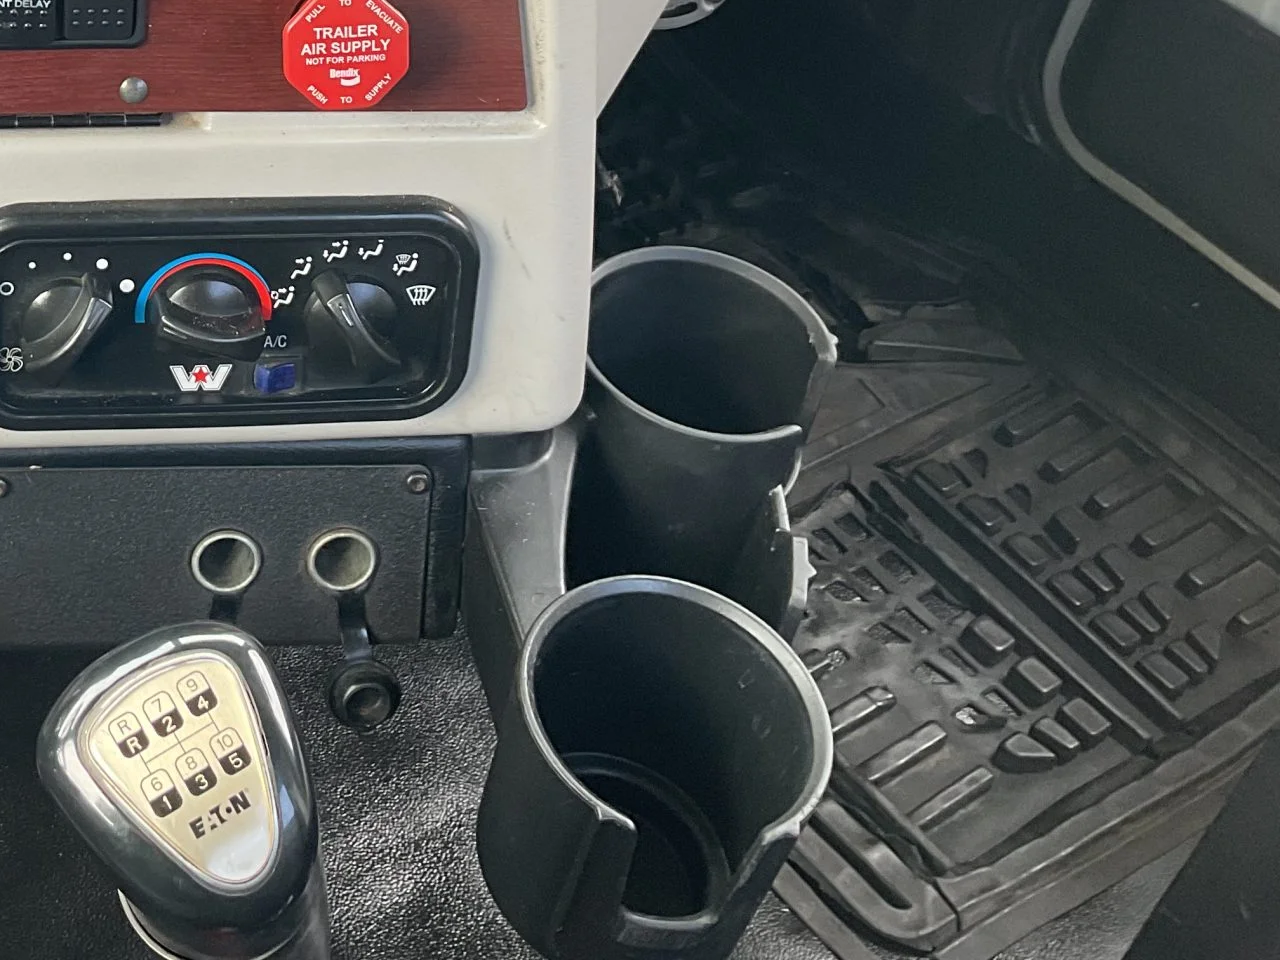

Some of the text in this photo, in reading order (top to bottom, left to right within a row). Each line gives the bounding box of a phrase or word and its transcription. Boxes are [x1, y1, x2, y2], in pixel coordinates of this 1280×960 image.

[14, 0, 51, 9] DELAY
[305, 4, 326, 23] PULL
[365, 0, 404, 35] EVACUATE
[312, 24, 379, 40] TRAILER
[300, 38, 391, 56] AIR SUPPLY
[305, 53, 386, 66] NOT FOR PARKING
[329, 67, 360, 79] Bendix
[307, 72, 393, 105] PUSH TO SUPPLY
[263, 334, 288, 348] A/C
[186, 678, 198, 692] 9
[150, 697, 162, 713] 7
[197, 695, 210, 710] 4
[116, 719, 132, 735] R
[161, 715, 177, 733] 2
[126, 737, 142, 754] R
[216, 733, 234, 752] 10
[185, 756, 198, 770] 8
[228, 752, 244, 769] 5
[150, 777, 164, 792] 6
[194, 773, 209, 790] 3
[161, 794, 173, 810] 1
